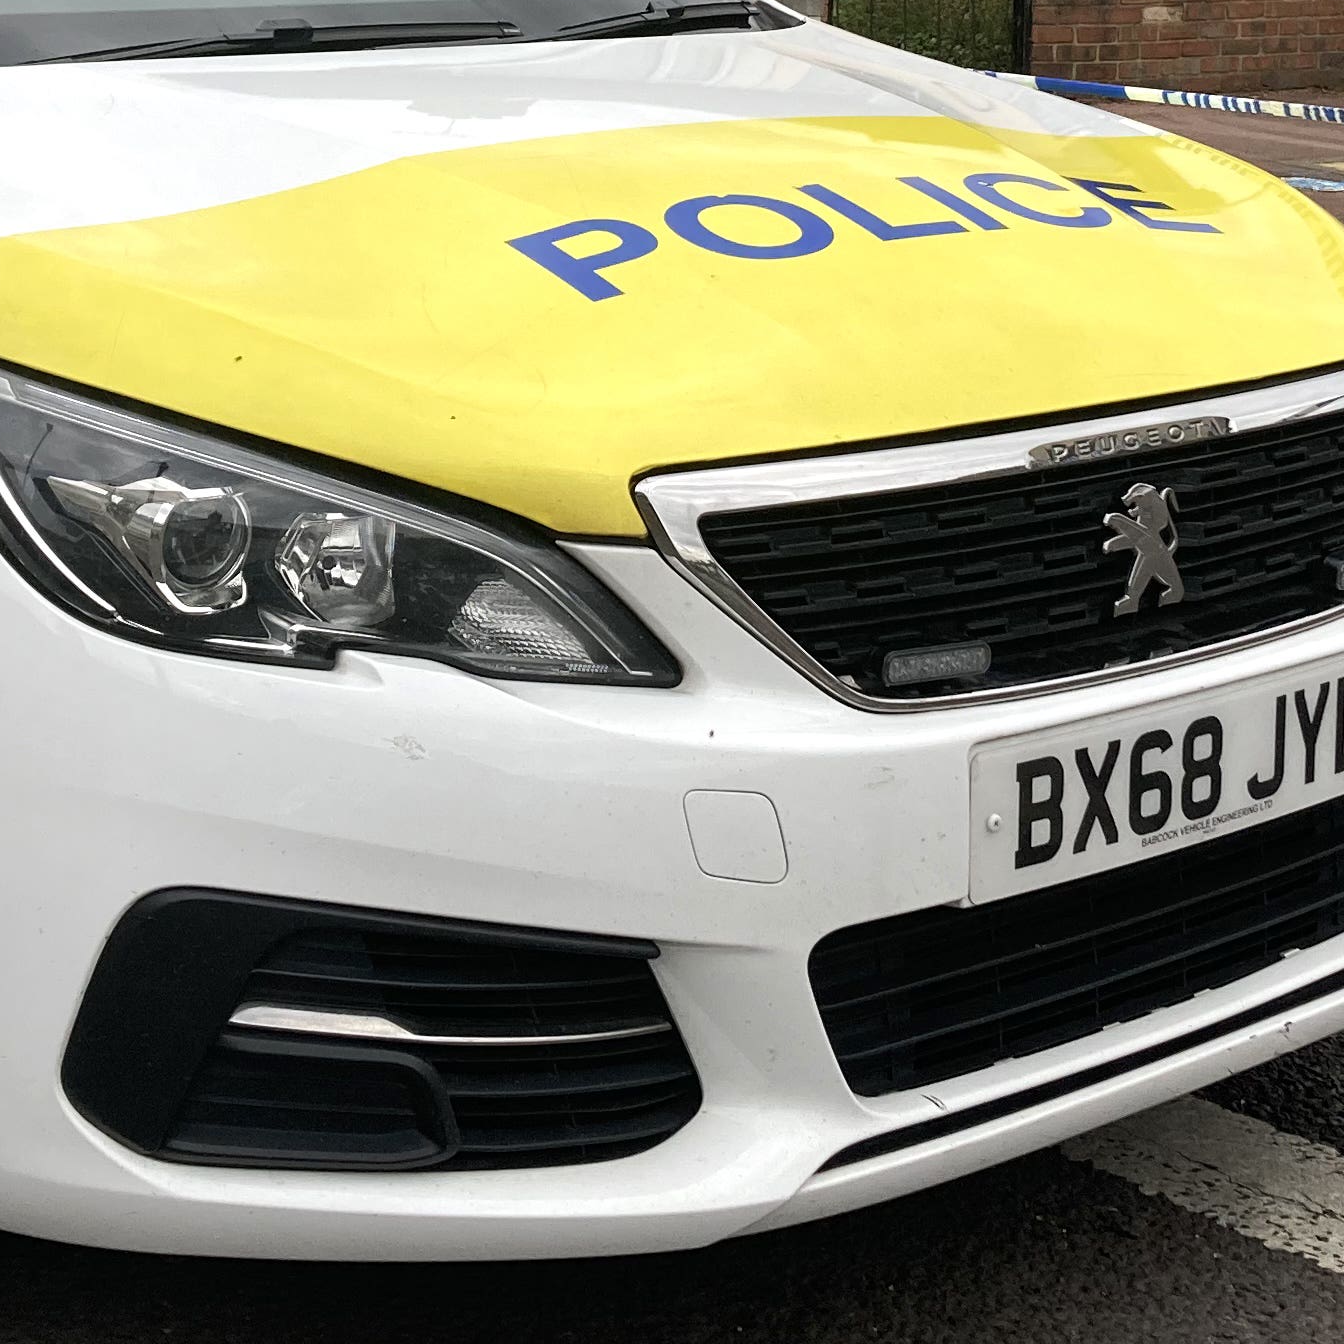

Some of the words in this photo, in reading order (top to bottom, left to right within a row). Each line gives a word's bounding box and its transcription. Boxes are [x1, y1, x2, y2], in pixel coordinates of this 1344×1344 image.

[505, 172, 1224, 302] POLICE
[1051, 420, 1205, 464] PEUGEOT
[1014, 715, 1223, 870] BX68
[1260, 799, 1274, 813] LTD
